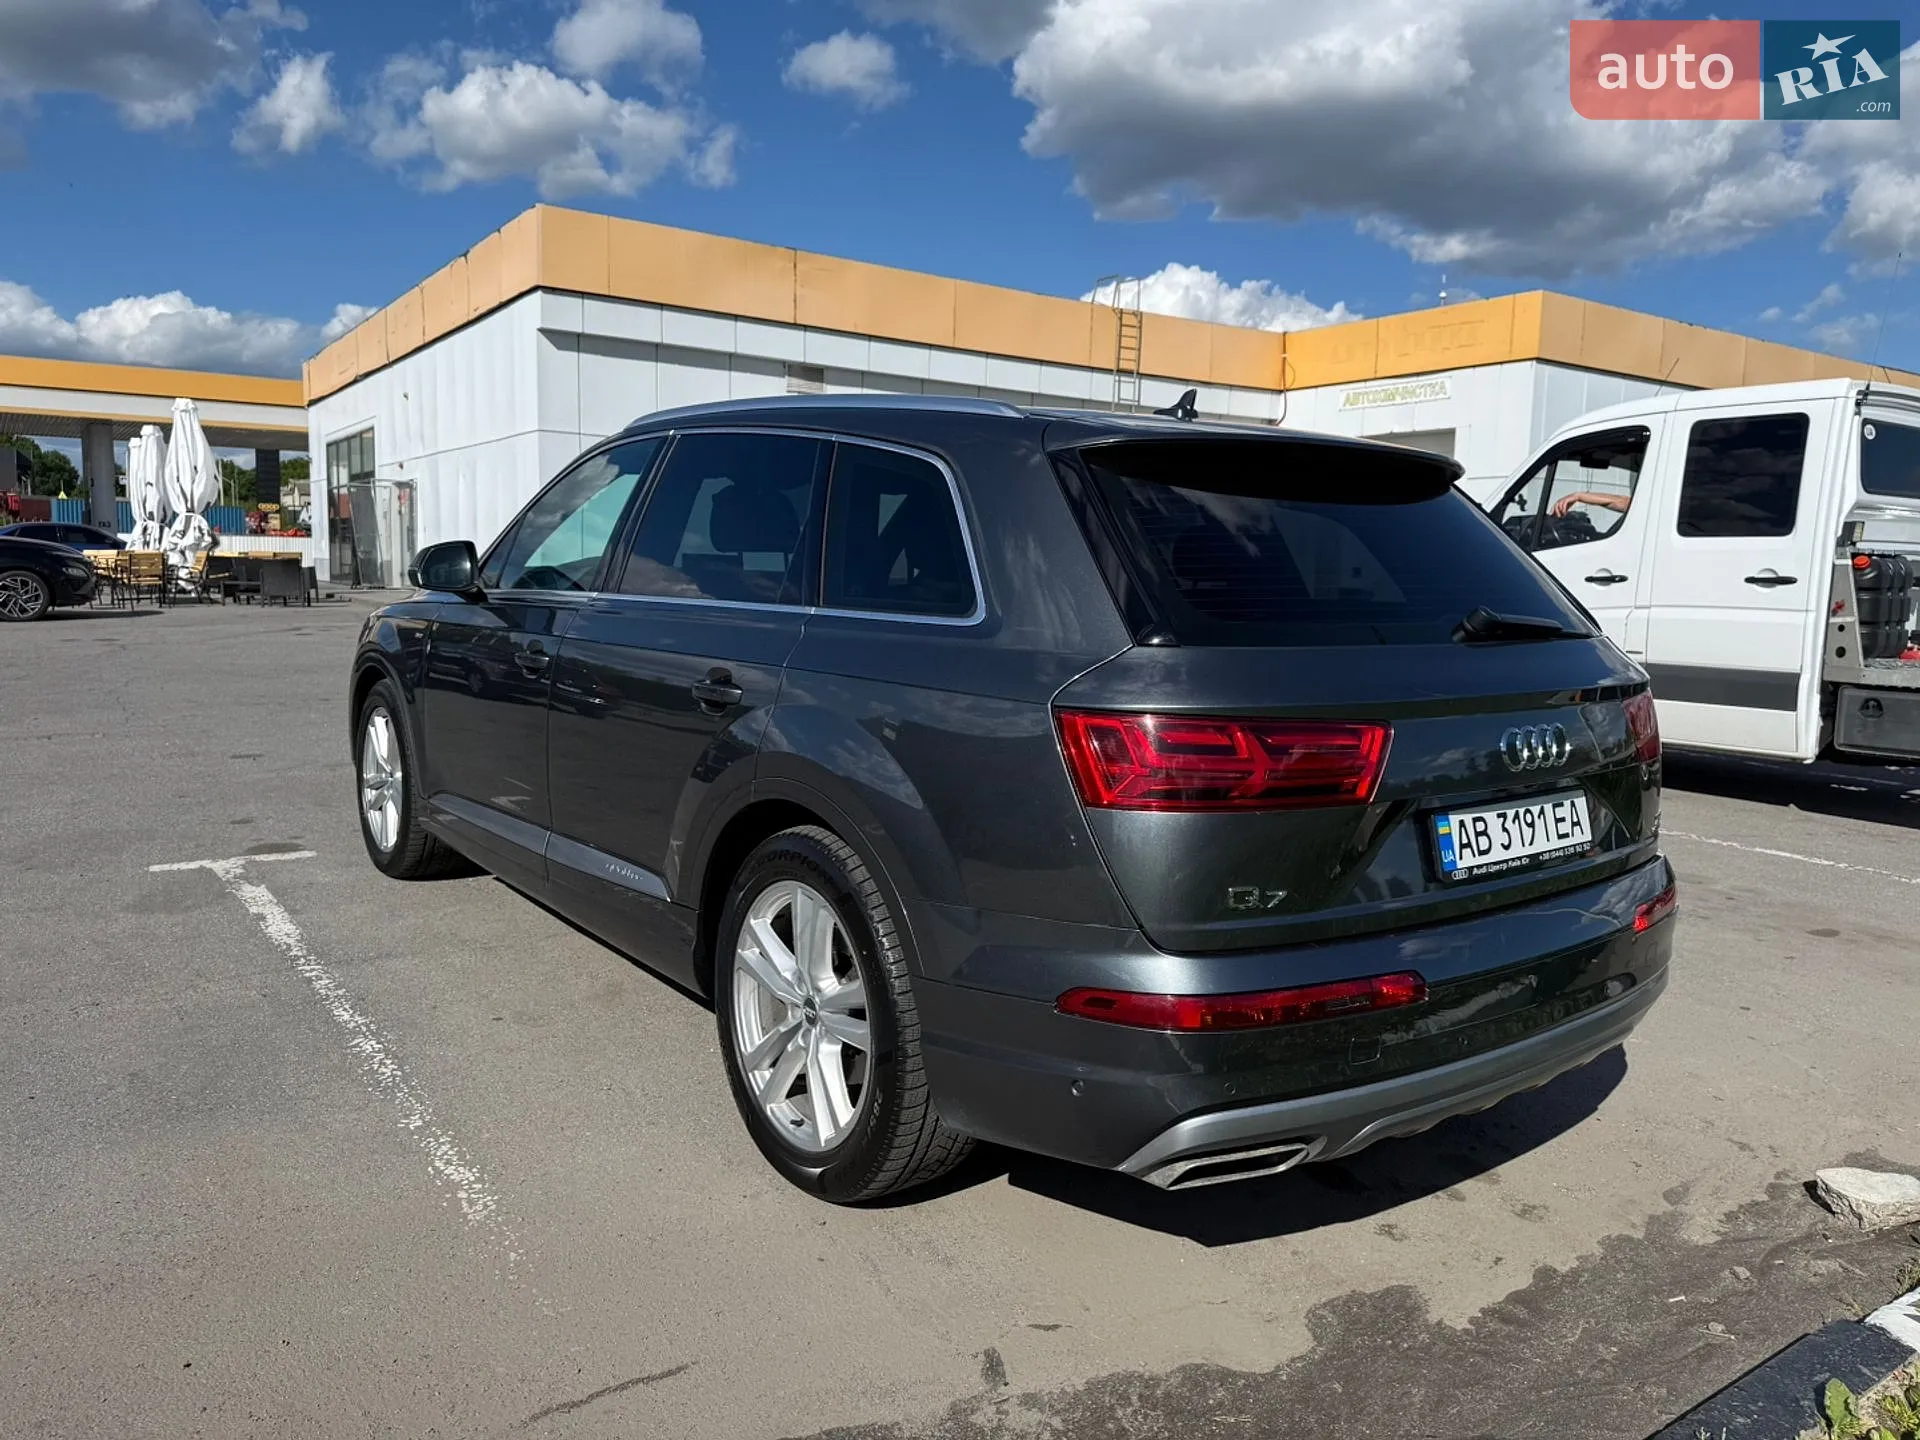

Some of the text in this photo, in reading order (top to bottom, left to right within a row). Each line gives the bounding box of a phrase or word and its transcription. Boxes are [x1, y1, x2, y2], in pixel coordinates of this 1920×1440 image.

[1458, 799, 1585, 861] AB 3191 EA
[1442, 849, 1456, 863] UA
[1227, 886, 1288, 909] Q7
